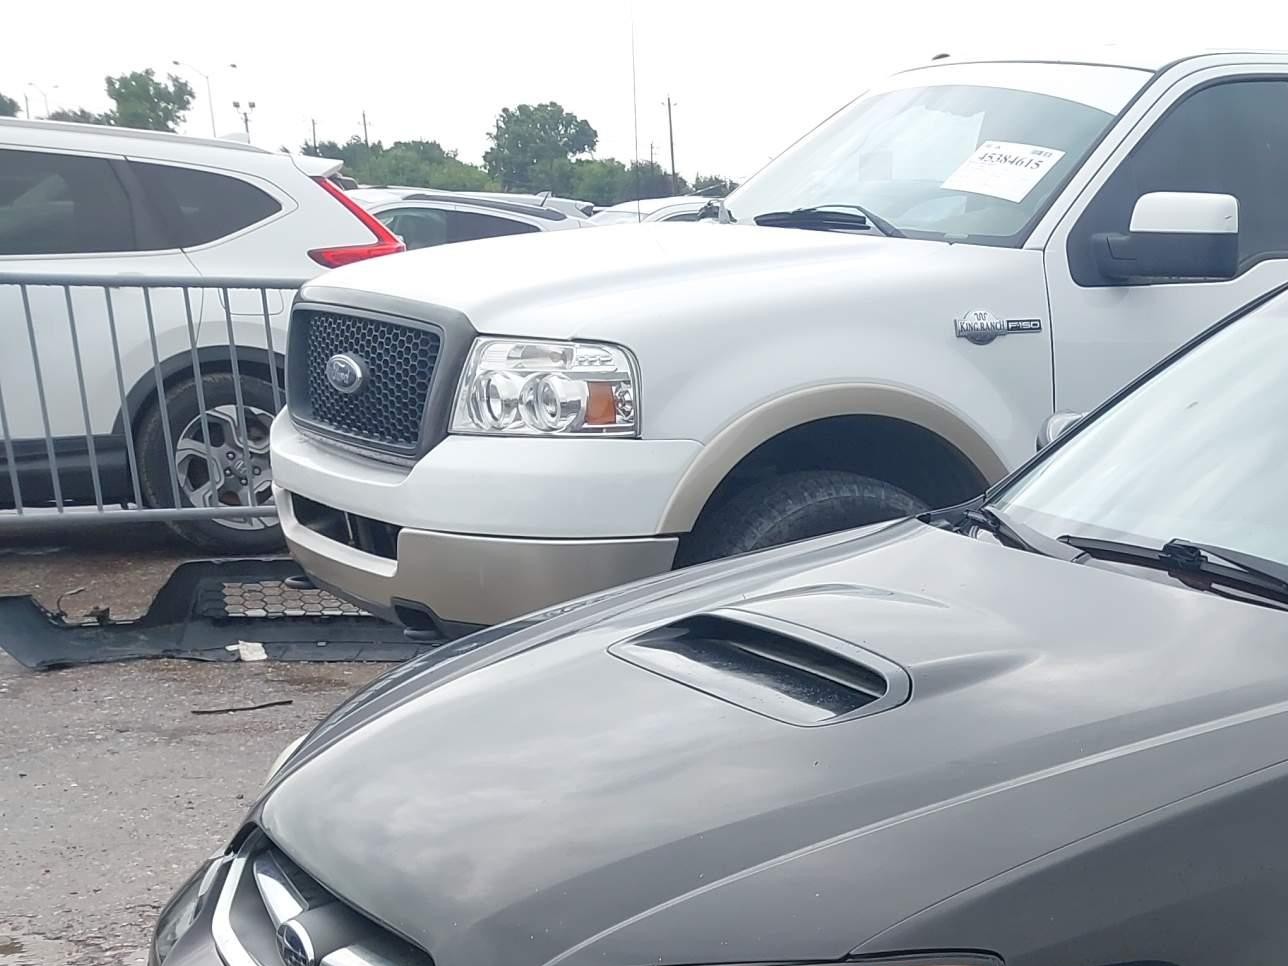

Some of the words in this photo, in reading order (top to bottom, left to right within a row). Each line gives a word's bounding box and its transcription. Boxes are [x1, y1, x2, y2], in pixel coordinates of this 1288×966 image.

[978, 152, 1044, 169] 45384615
[959, 321, 979, 332] KING
[981, 321, 1005, 332] RANCH
